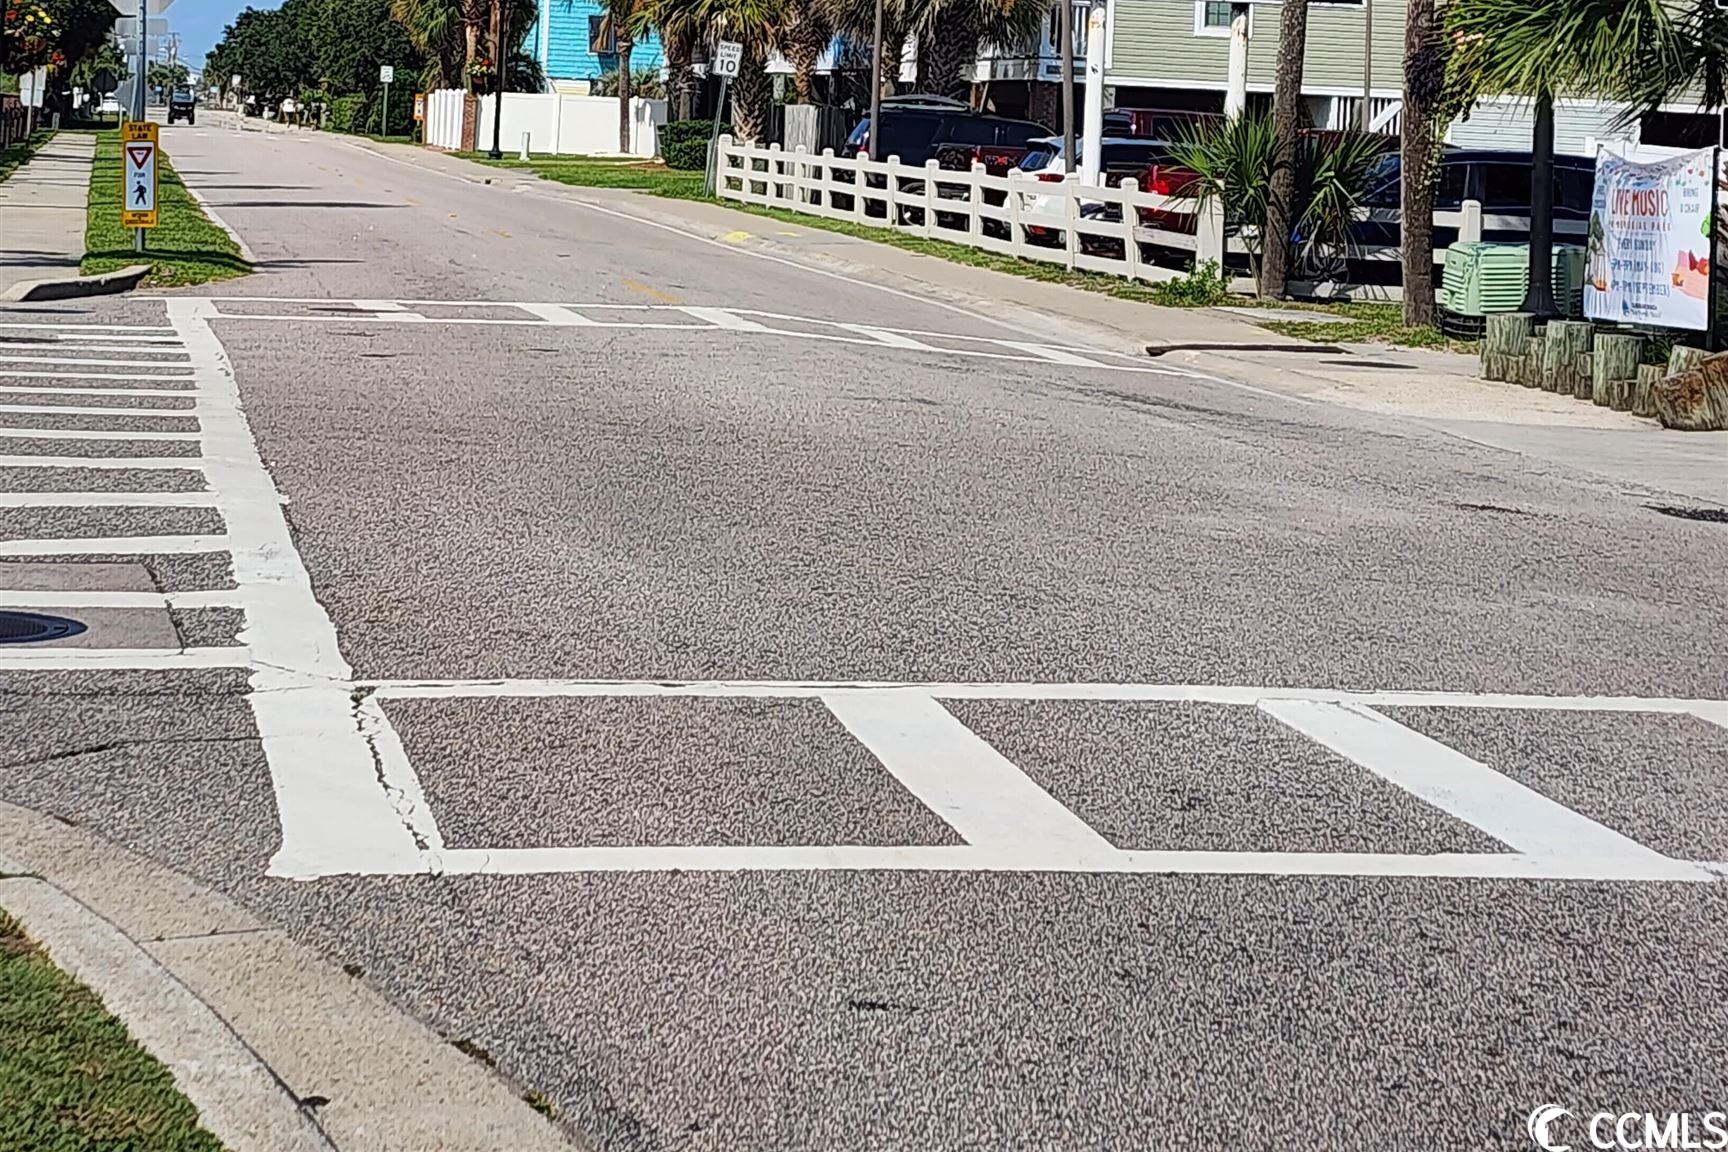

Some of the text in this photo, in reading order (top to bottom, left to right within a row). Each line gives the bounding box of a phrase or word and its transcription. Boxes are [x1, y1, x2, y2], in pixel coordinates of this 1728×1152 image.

[720, 44, 740, 52] SPEED
[720, 59, 736, 73] 10
[128, 124, 152, 132] STATE
[1611, 188, 1669, 217] LIVE MUSIC
